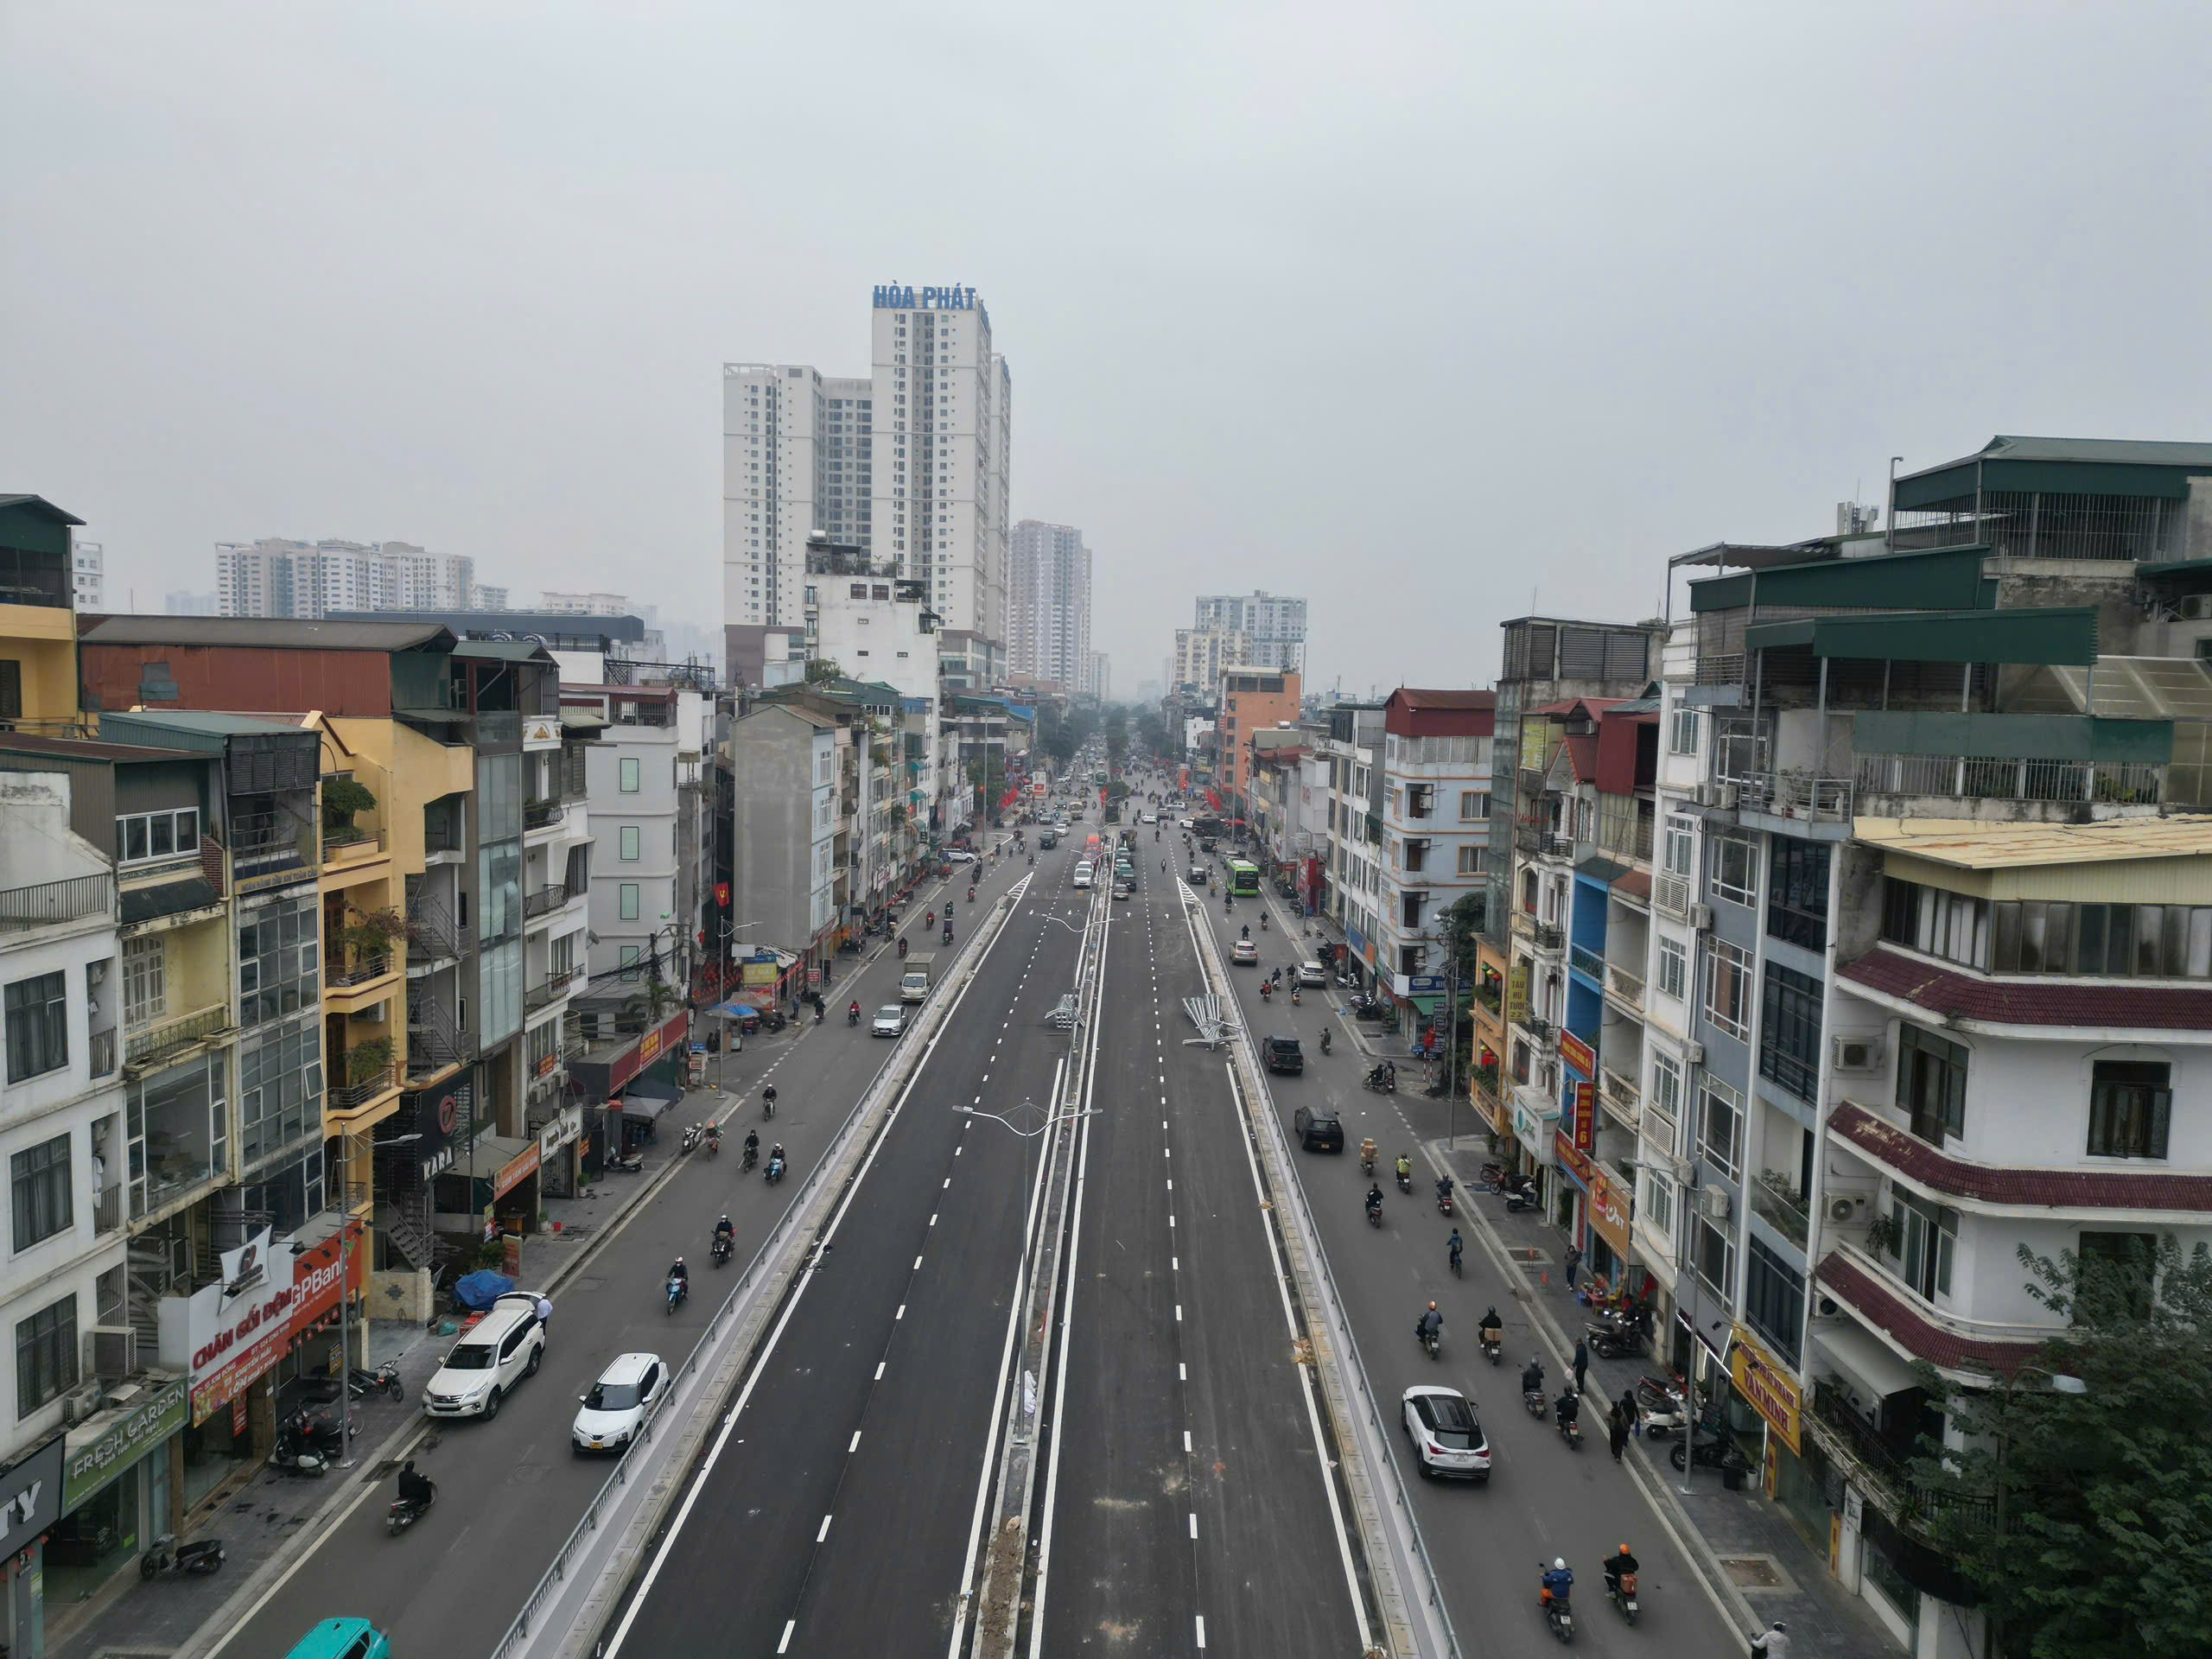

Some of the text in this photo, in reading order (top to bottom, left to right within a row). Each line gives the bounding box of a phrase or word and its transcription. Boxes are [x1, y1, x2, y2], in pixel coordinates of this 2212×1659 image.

[874, 280, 976, 310] HÒA PHÁT
[1580, 1131, 1587, 1143] 6
[423, 1146, 453, 1182] KARA
[193, 1328, 233, 1370] CHĂN
[236, 1303, 260, 1339] GỐI
[263, 1287, 292, 1322] ĐỆM
[72, 1430, 123, 1480] FRESH
[127, 1384, 184, 1437] GARDEN
